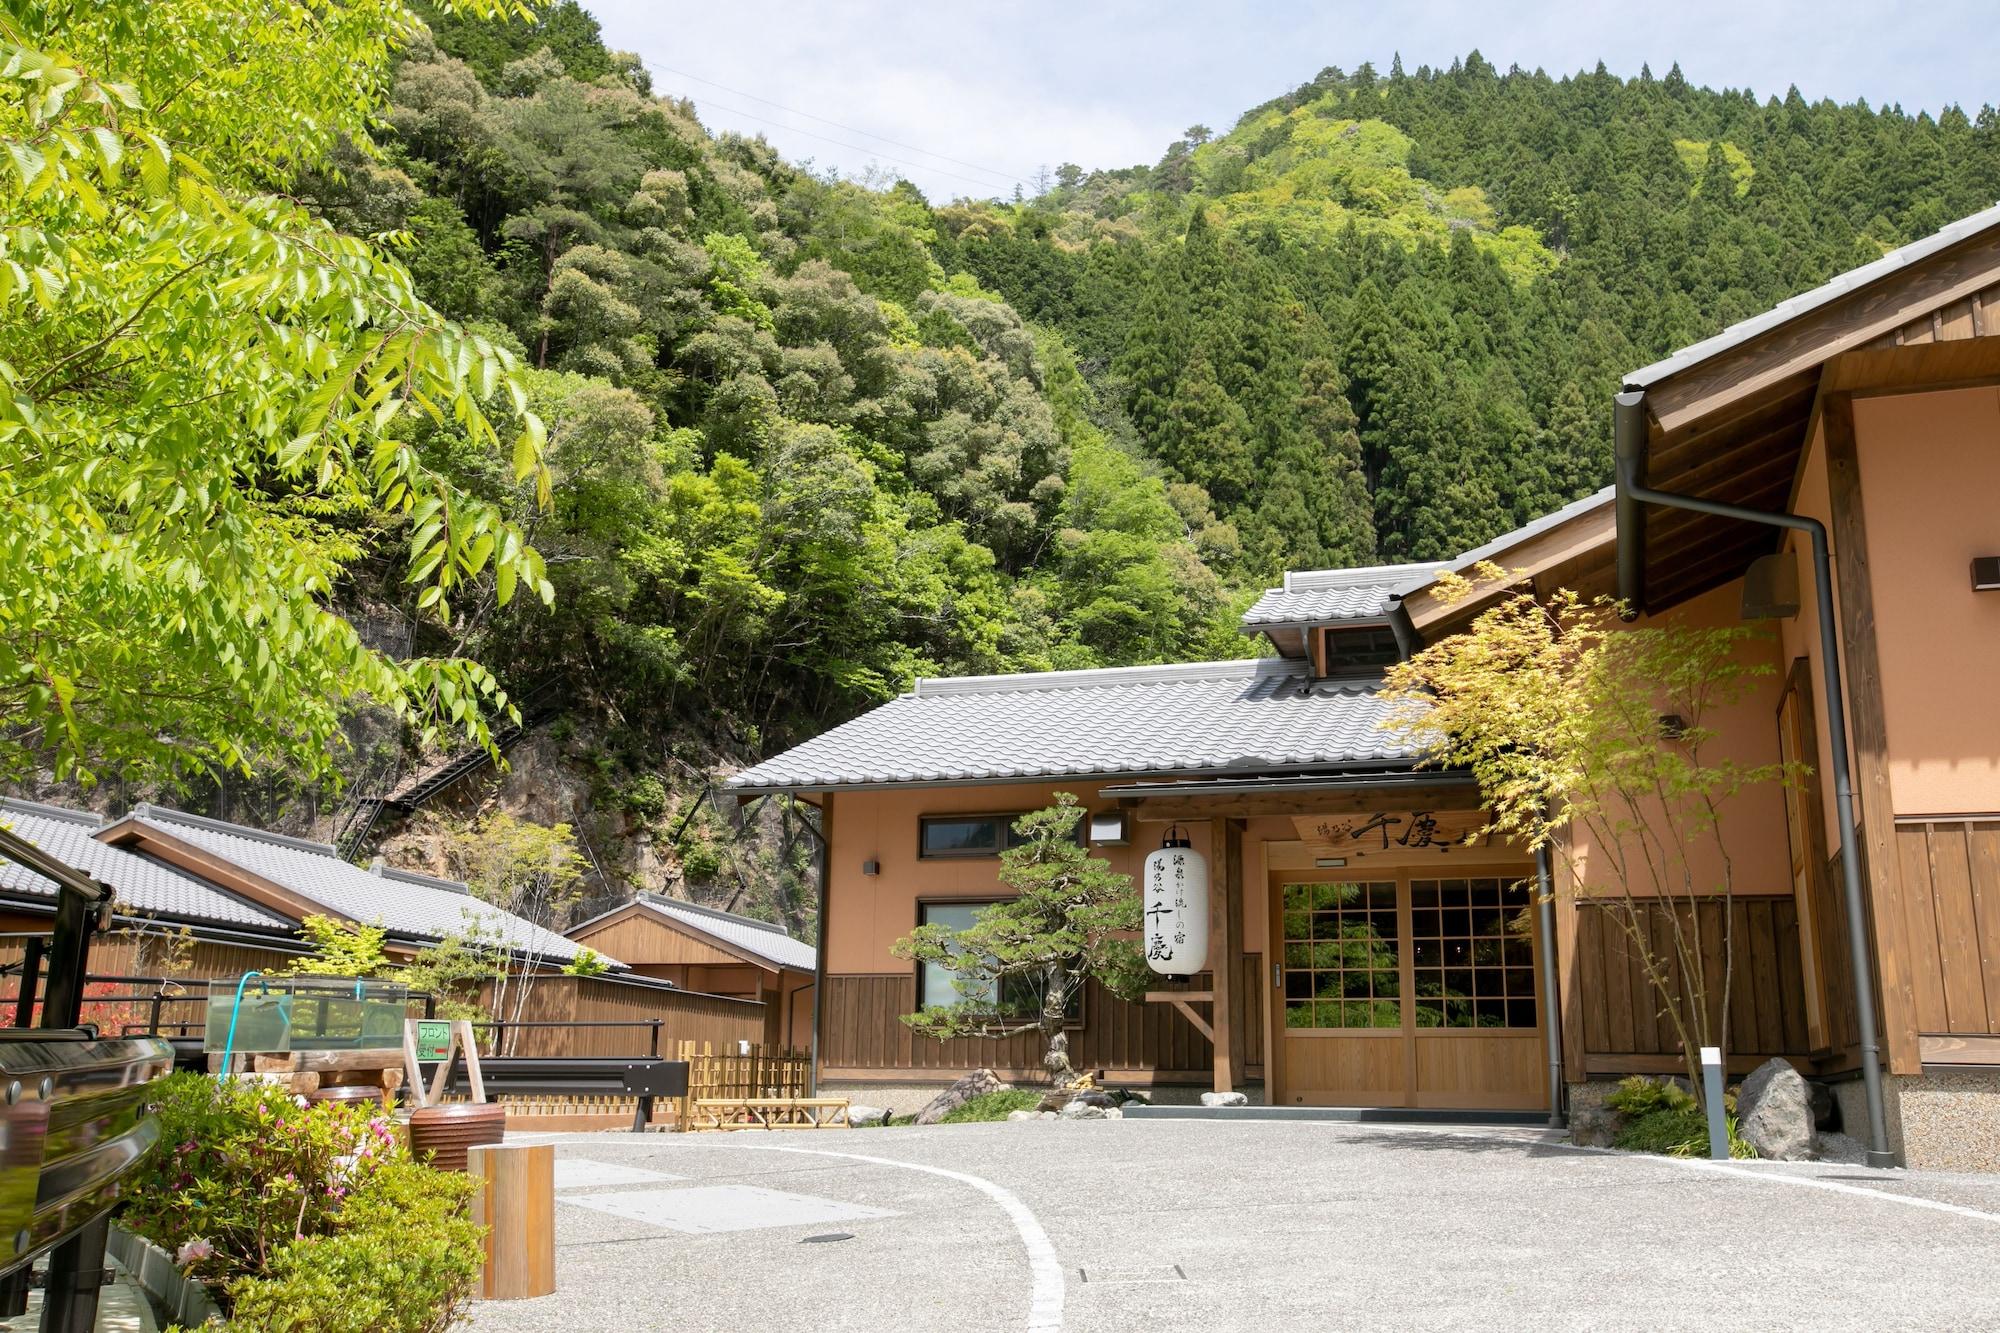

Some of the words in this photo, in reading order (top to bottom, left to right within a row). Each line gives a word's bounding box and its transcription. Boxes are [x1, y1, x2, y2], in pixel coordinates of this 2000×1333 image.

[1173, 854, 1187, 945] 源泉かけ流しの宿
[420, 1027, 448, 1039] フロント
[417, 1044, 435, 1058] 受付
